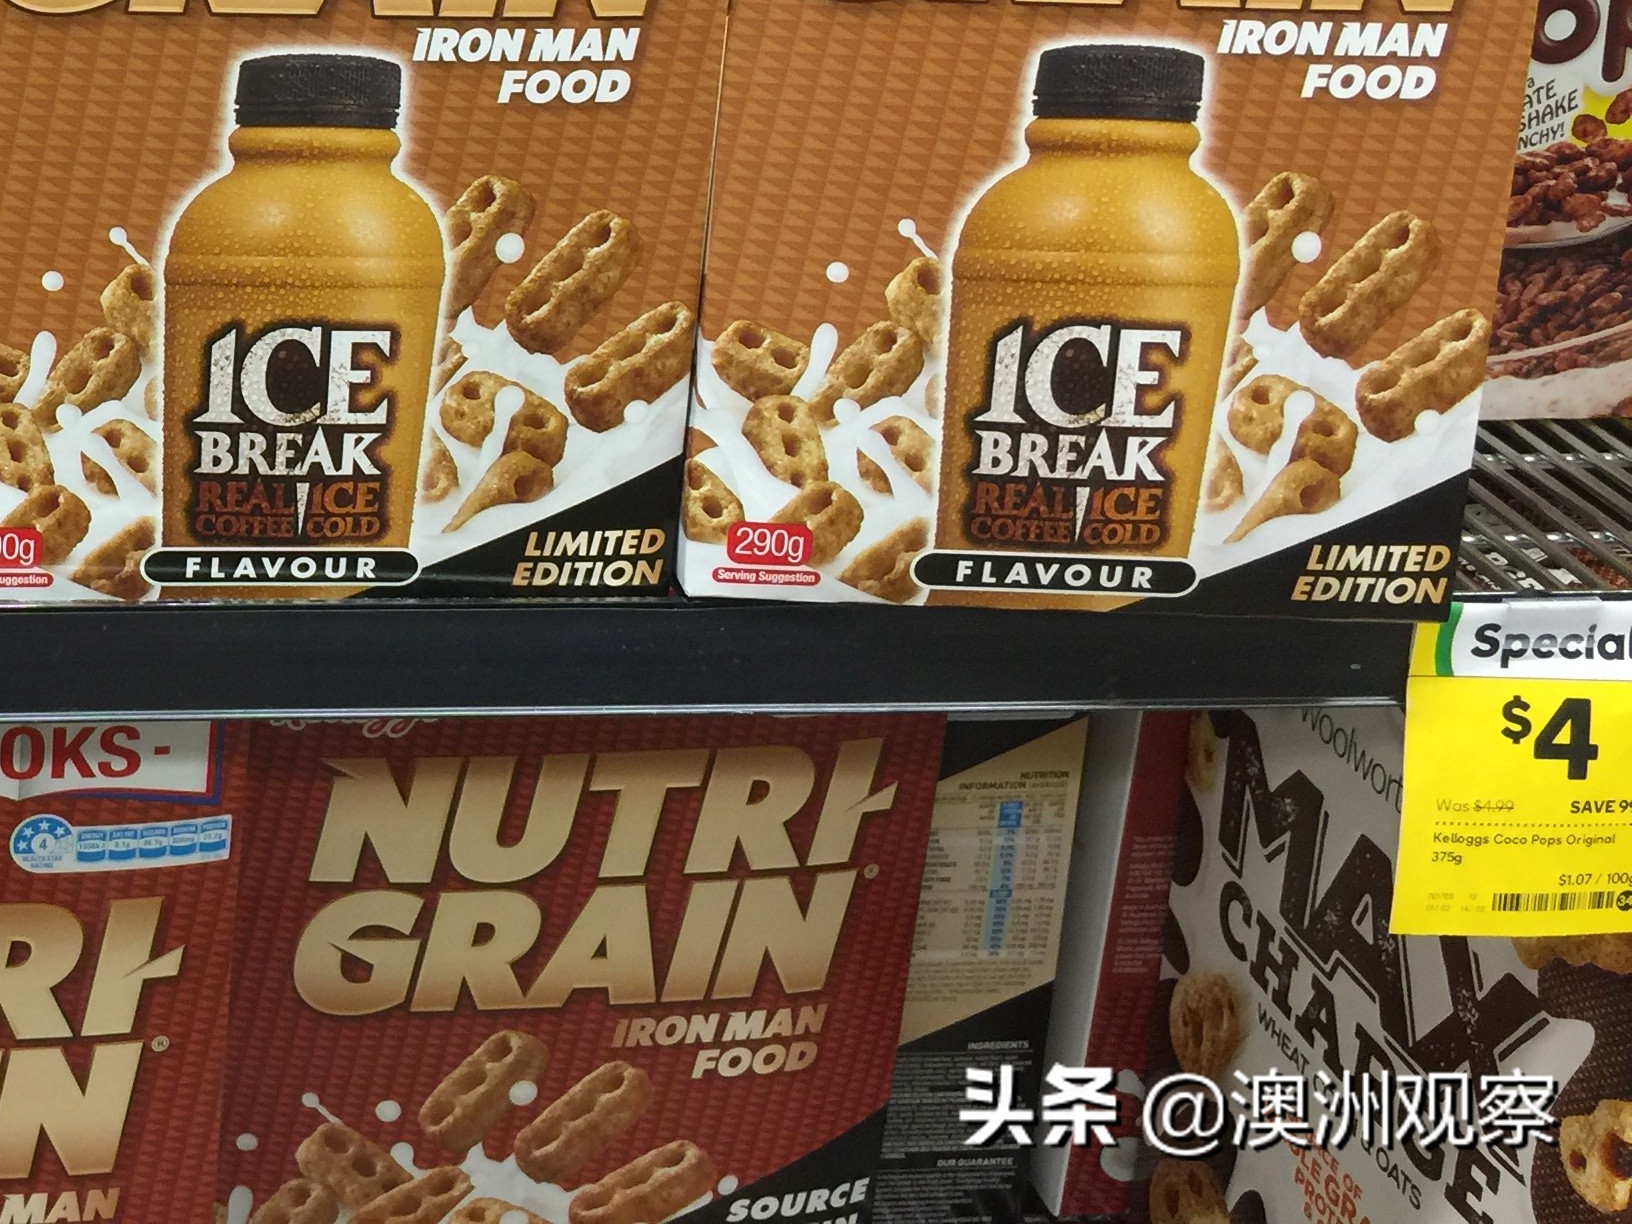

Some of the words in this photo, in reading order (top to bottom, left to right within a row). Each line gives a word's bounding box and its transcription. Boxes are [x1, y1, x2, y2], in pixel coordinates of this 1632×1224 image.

[412, 27, 529, 64] IRON
[528, 27, 641, 64] MAN
[1216, 19, 1330, 57] IRON
[1334, 21, 1449, 58] MAN
[497, 70, 633, 105] FOOD
[1300, 63, 1438, 101] FOOD
[191, 327, 394, 429] ICE
[972, 325, 1181, 429] ICE
[193, 430, 380, 478] BREAK
[972, 430, 1166, 481] BREAK
[524, 528, 667, 558] LIMITED
[735, 526, 806, 564] 290g
[1305, 543, 1452, 575] LIMITED
[184, 554, 378, 580] FLAVOUR
[512, 558, 664, 587] EDITION
[717, 569, 757, 584] Serving
[758, 570, 817, 584] Suggestion
[955, 559, 1154, 589] FLAVOUR
[1291, 574, 1450, 605] EDITION
[1501, 695, 1599, 781] $4
[959, 780, 1027, 792] INFORMATION
[1436, 799, 1470, 813] Was
[1473, 799, 1515, 814] $4.99
[1570, 800, 1616, 814] SAVE
[1431, 851, 1463, 865] 375g
[1433, 832, 1489, 847] Kelloggs
[1494, 833, 1528, 845] Coco
[1531, 834, 1562, 847] Pops
[1566, 833, 1616, 847] Original
[1558, 873, 1593, 887] $1.07
[292, 869, 860, 1017] GRAIN
[611, 1012, 722, 1048] IRON
[723, 1004, 828, 1041] MAN
[1256, 1002, 1310, 1075] WHEAT
[690, 1043, 819, 1080] FOOD
[1376, 1147, 1422, 1210] OATS
[0, 1187, 121, 1224] MAN
[725, 1177, 870, 1222] SOURCE
